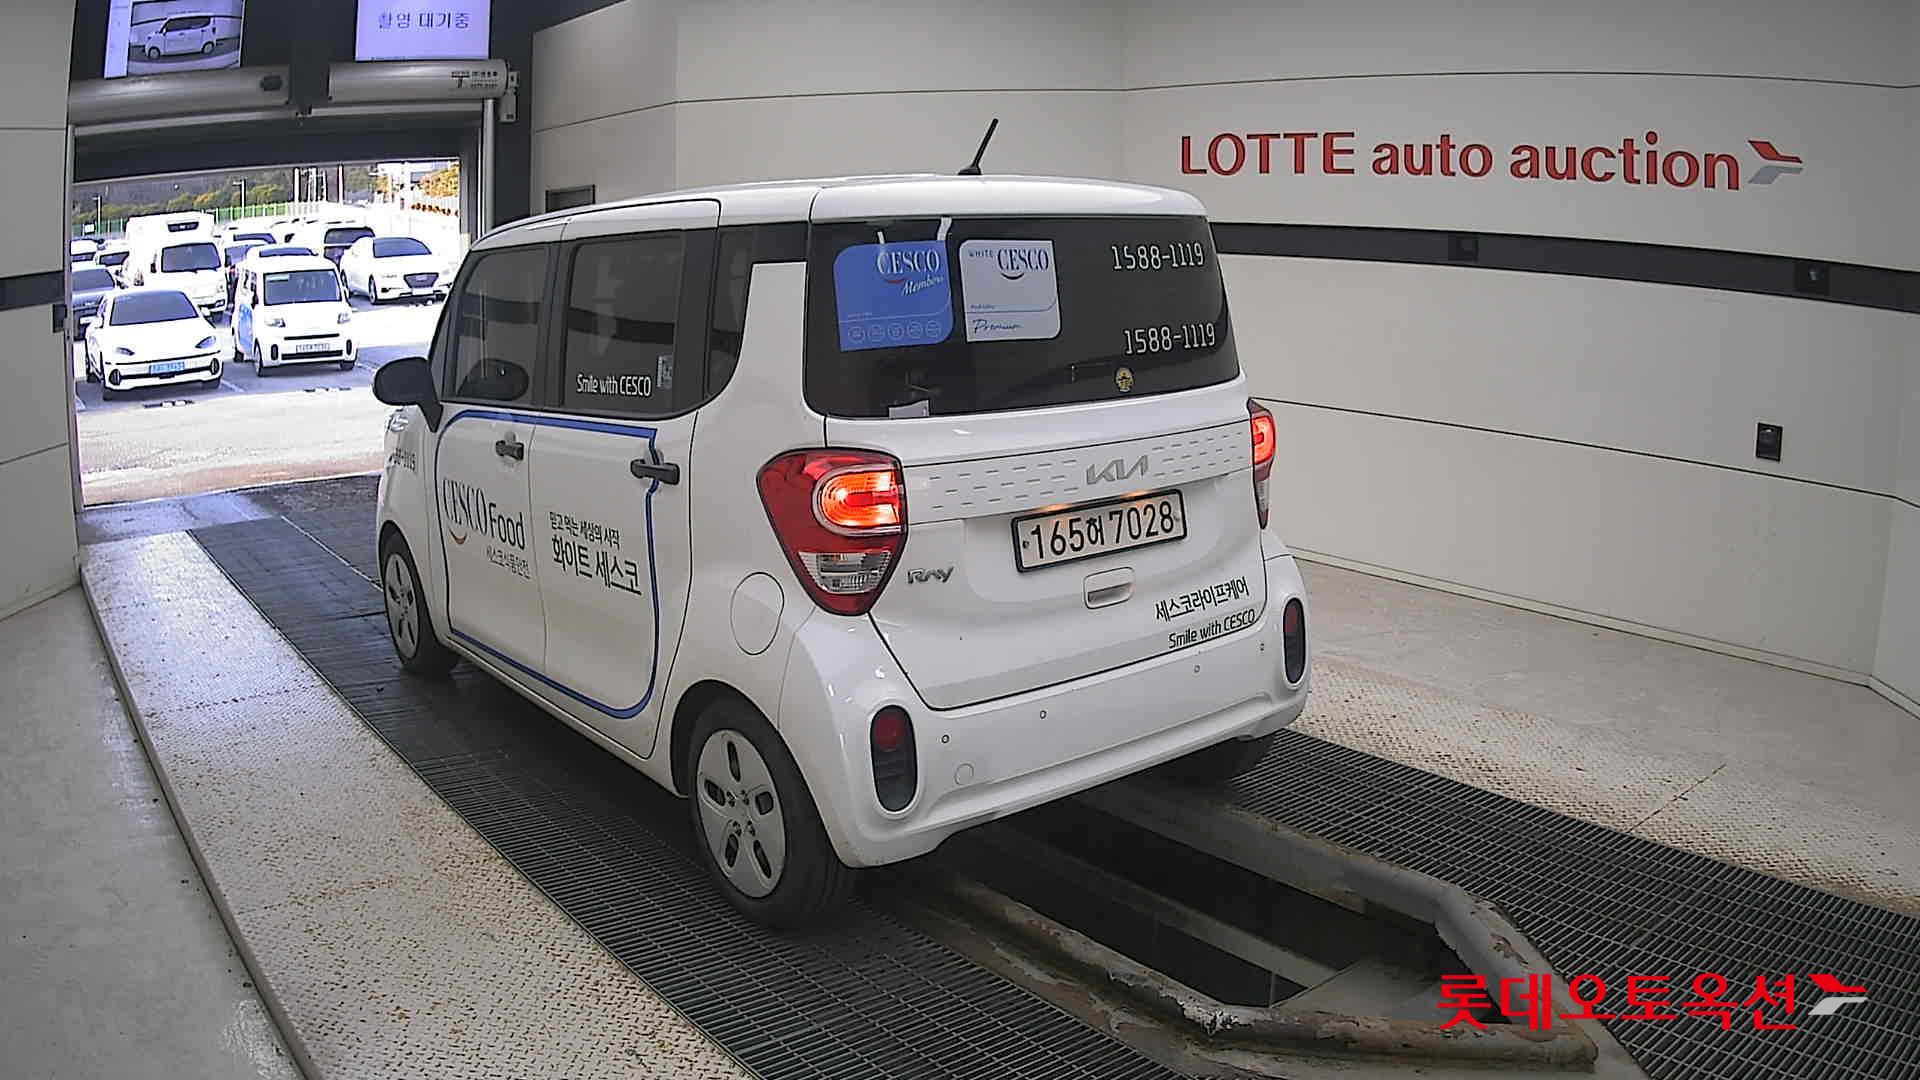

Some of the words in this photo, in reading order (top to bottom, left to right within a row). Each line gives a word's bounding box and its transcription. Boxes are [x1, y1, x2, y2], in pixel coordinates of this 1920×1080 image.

[419, 12, 470, 29] 대기중
[1181, 132, 1355, 175] LOTTE
[1372, 134, 1493, 178] auto
[1510, 131, 1740, 190] auction
[877, 249, 940, 274] CESCO
[997, 248, 1049, 271] CESCO
[1111, 242, 1205, 270] 1588-1119
[1124, 322, 1215, 354] 1588-1119
[577, 374, 598, 392] Smile
[600, 375, 618, 394] with
[620, 376, 651, 396] CESCO
[443, 479, 487, 536] CESCO
[489, 502, 525, 550] Food
[1109, 500, 1174, 543] 7028
[552, 534, 593, 578] 화이트
[596, 551, 642, 596] 세스코
[1155, 576, 1250, 622] 세스코라이프케어
[1168, 628, 1198, 649] Smile
[1200, 620, 1222, 640] with
[1223, 608, 1256, 631] CESCO
